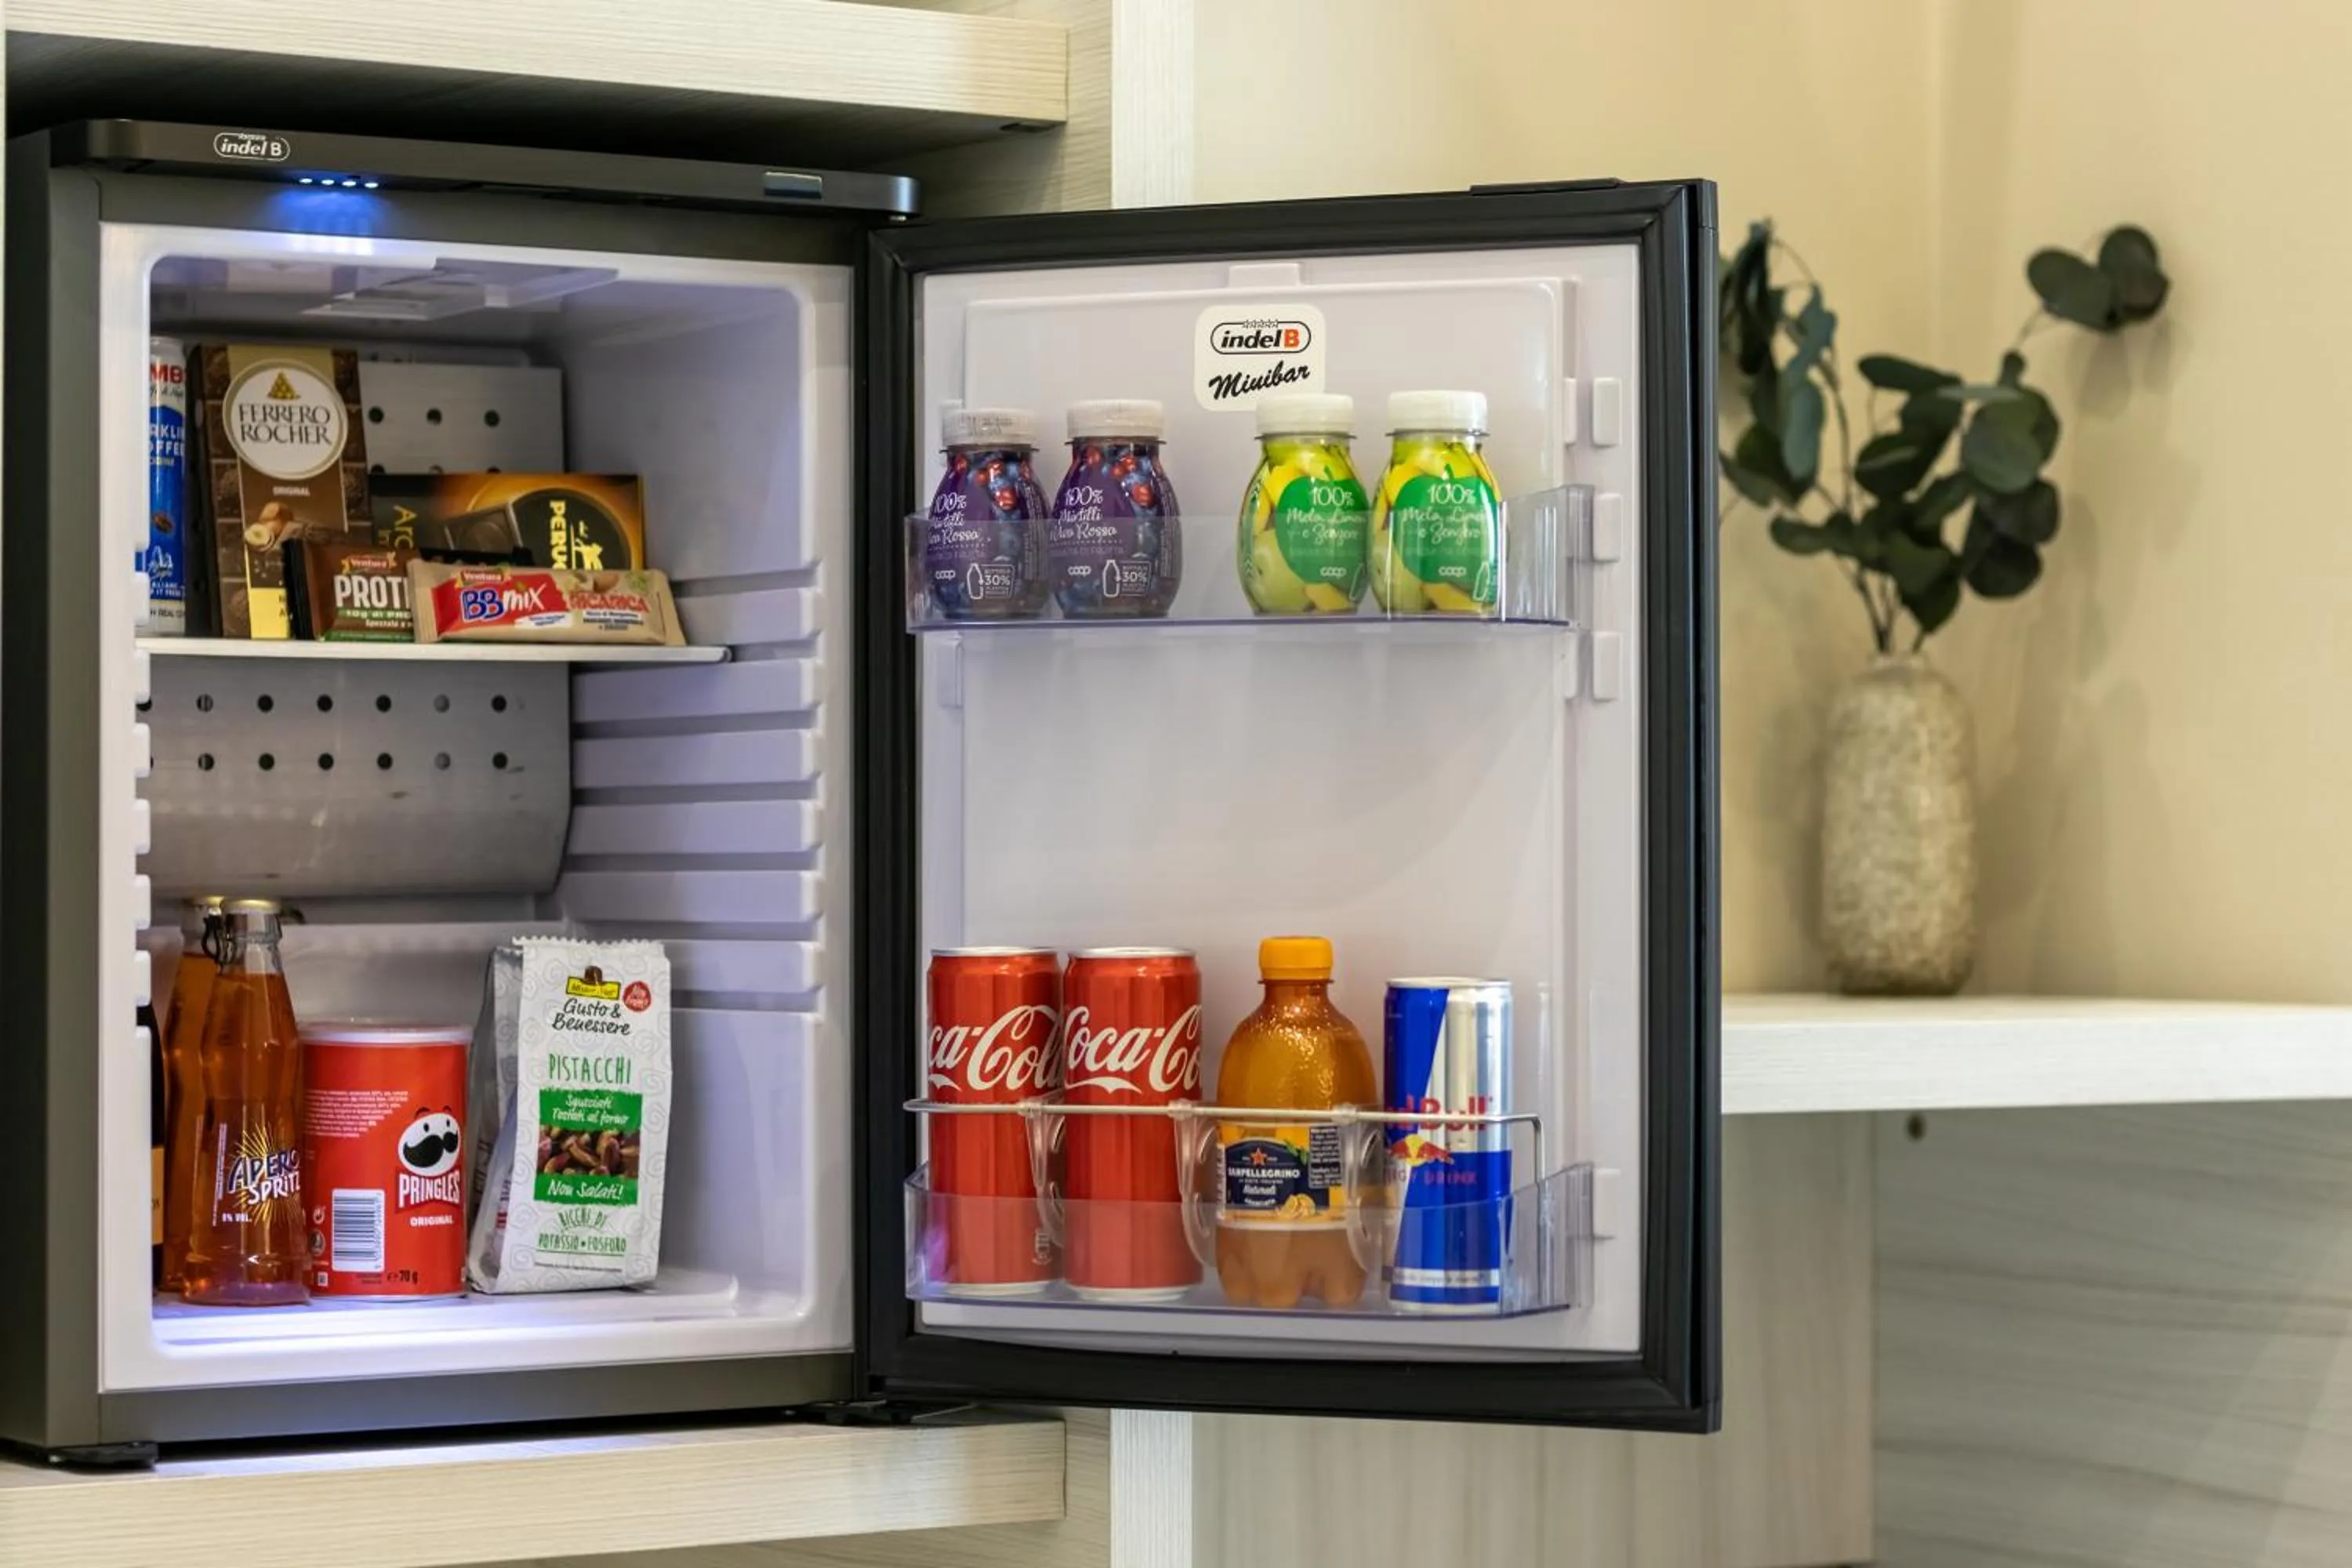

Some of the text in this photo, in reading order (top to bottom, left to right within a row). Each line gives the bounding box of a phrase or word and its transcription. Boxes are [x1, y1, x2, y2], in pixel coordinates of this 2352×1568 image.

[220, 138, 283, 157] indel B
[1221, 328, 1301, 350] indel B
[1207, 360, 1311, 401] Minibar
[238, 403, 331, 424] FERRERO
[240, 423, 332, 446] ROCHER
[1309, 485, 1355, 507] 100%
[1427, 483, 1477, 505] 100%
[550, 500, 565, 569] PERU
[983, 574, 1011, 586] 30%
[1319, 566, 1347, 579] coop
[1439, 566, 1467, 579] coop
[563, 997, 622, 1019] Gusto &
[551, 1011, 632, 1036] Benessere
[549, 1053, 632, 1085] PISTACCHI
[397, 1170, 461, 1209] PRINGLES
[547, 1178, 575, 1196] Non
[409, 1214, 454, 1228] ORIGINAL
[399, 1269, 411, 1283] 70
